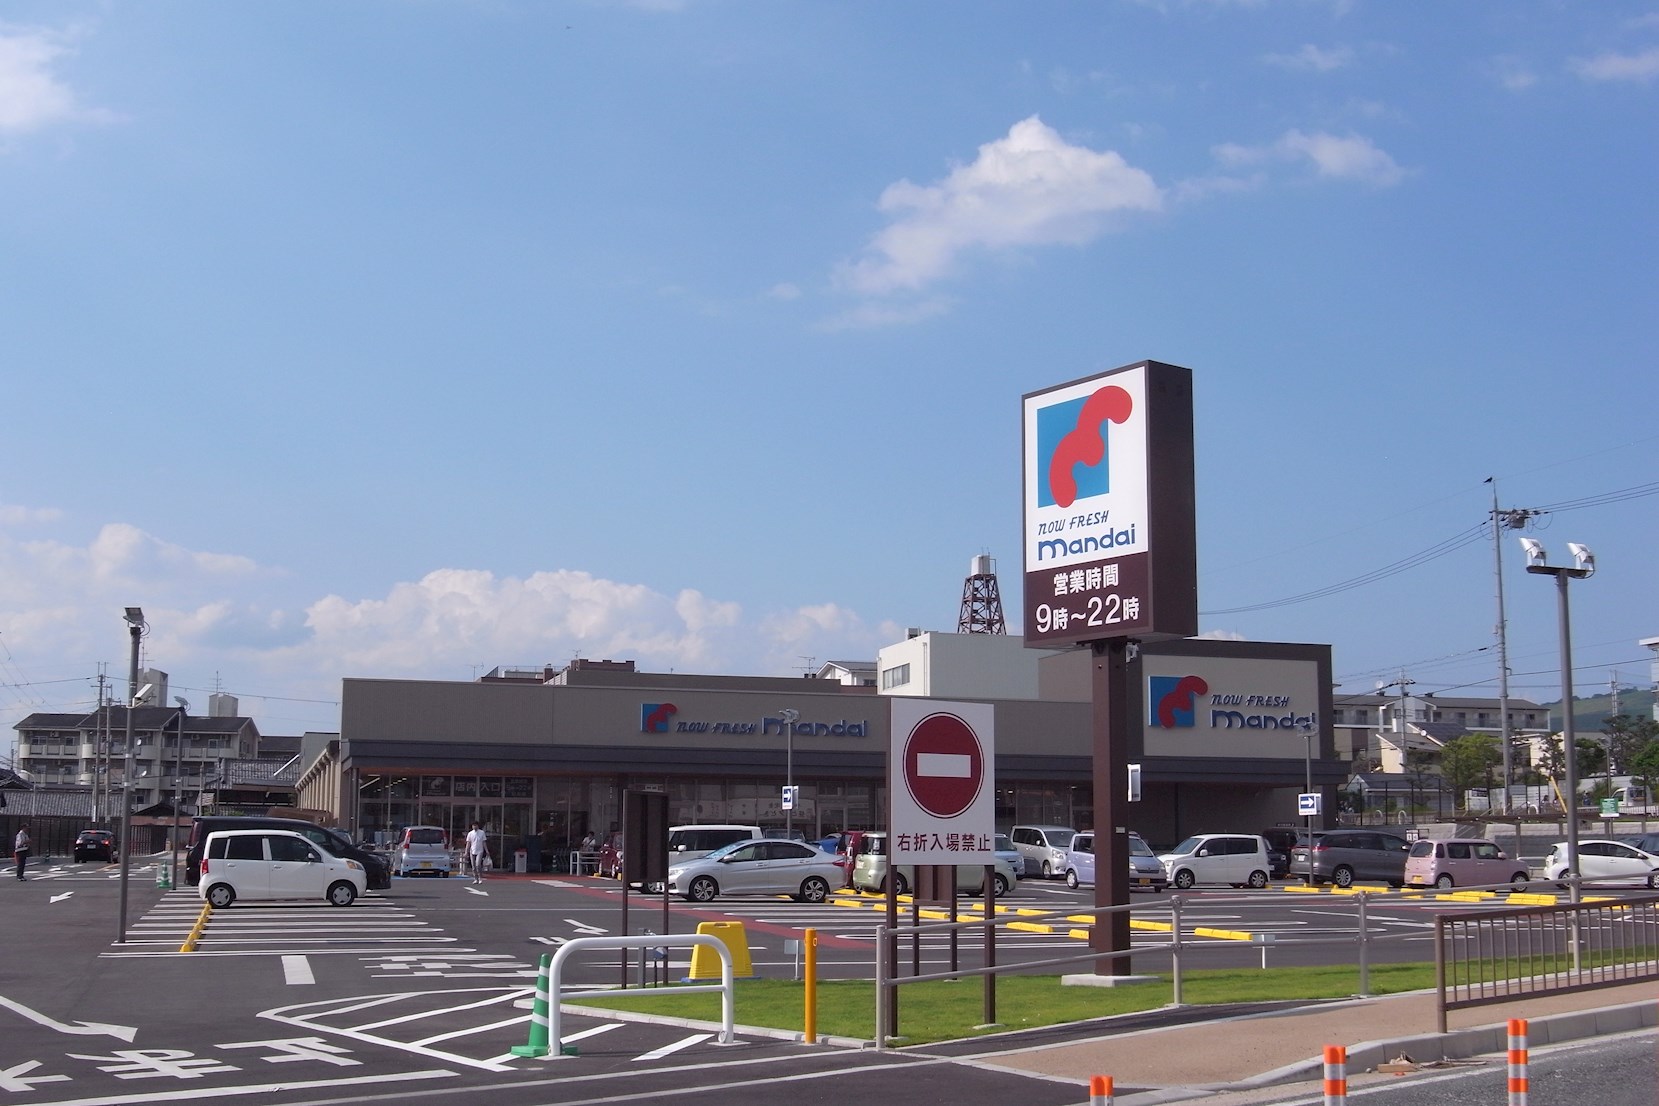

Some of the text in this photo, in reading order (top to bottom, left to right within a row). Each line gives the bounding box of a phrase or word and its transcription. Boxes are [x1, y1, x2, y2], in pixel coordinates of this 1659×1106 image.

[1069, 510, 1109, 530] FRESH
[1038, 524, 1136, 561] mandai
[1053, 564, 1119, 596] 営業時間
[1246, 695, 1289, 707] FRESH
[711, 722, 757, 735] FRESH
[761, 717, 868, 737] mandai
[1210, 709, 1316, 730] mandai
[897, 833, 991, 852] 右折入場禁止
